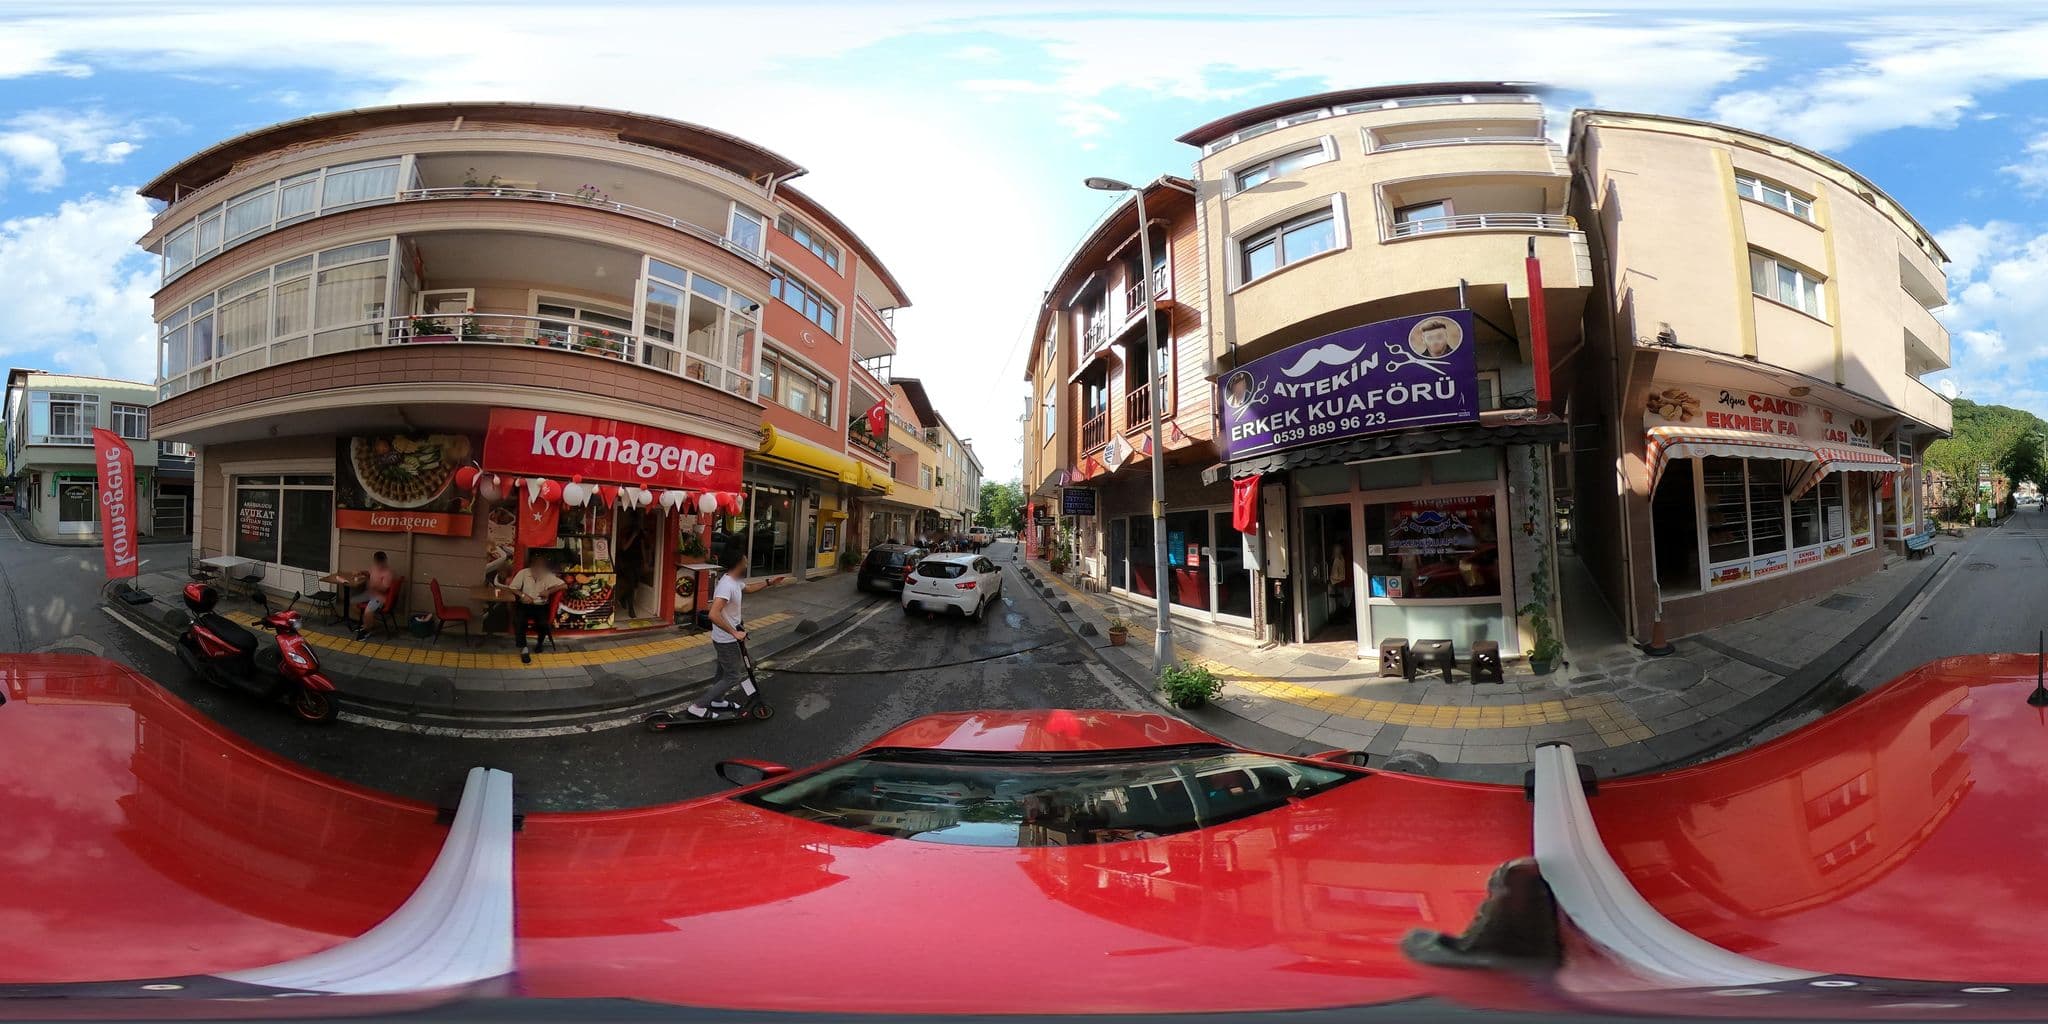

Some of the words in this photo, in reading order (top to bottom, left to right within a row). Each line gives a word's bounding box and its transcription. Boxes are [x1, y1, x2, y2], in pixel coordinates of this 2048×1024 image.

[1273, 352, 1379, 398] AYTEKİN
[1231, 408, 1300, 441] ERKEK
[1308, 376, 1456, 421] KUAFÖRÜ
[1748, 394, 1833, 425] ÇAKIR
[1273, 427, 1305, 445] 0539
[1309, 421, 1336, 437] 889
[1340, 416, 1360, 431] 96
[1365, 411, 1386, 426] 23
[1706, 411, 1774, 433] EKMEK
[1778, 420, 1848, 443] FAKASI
[531, 415, 715, 478] komagene
[103, 446, 136, 567] komagene
[240, 508, 275, 519] AVUKAT
[370, 513, 437, 530] komagene
